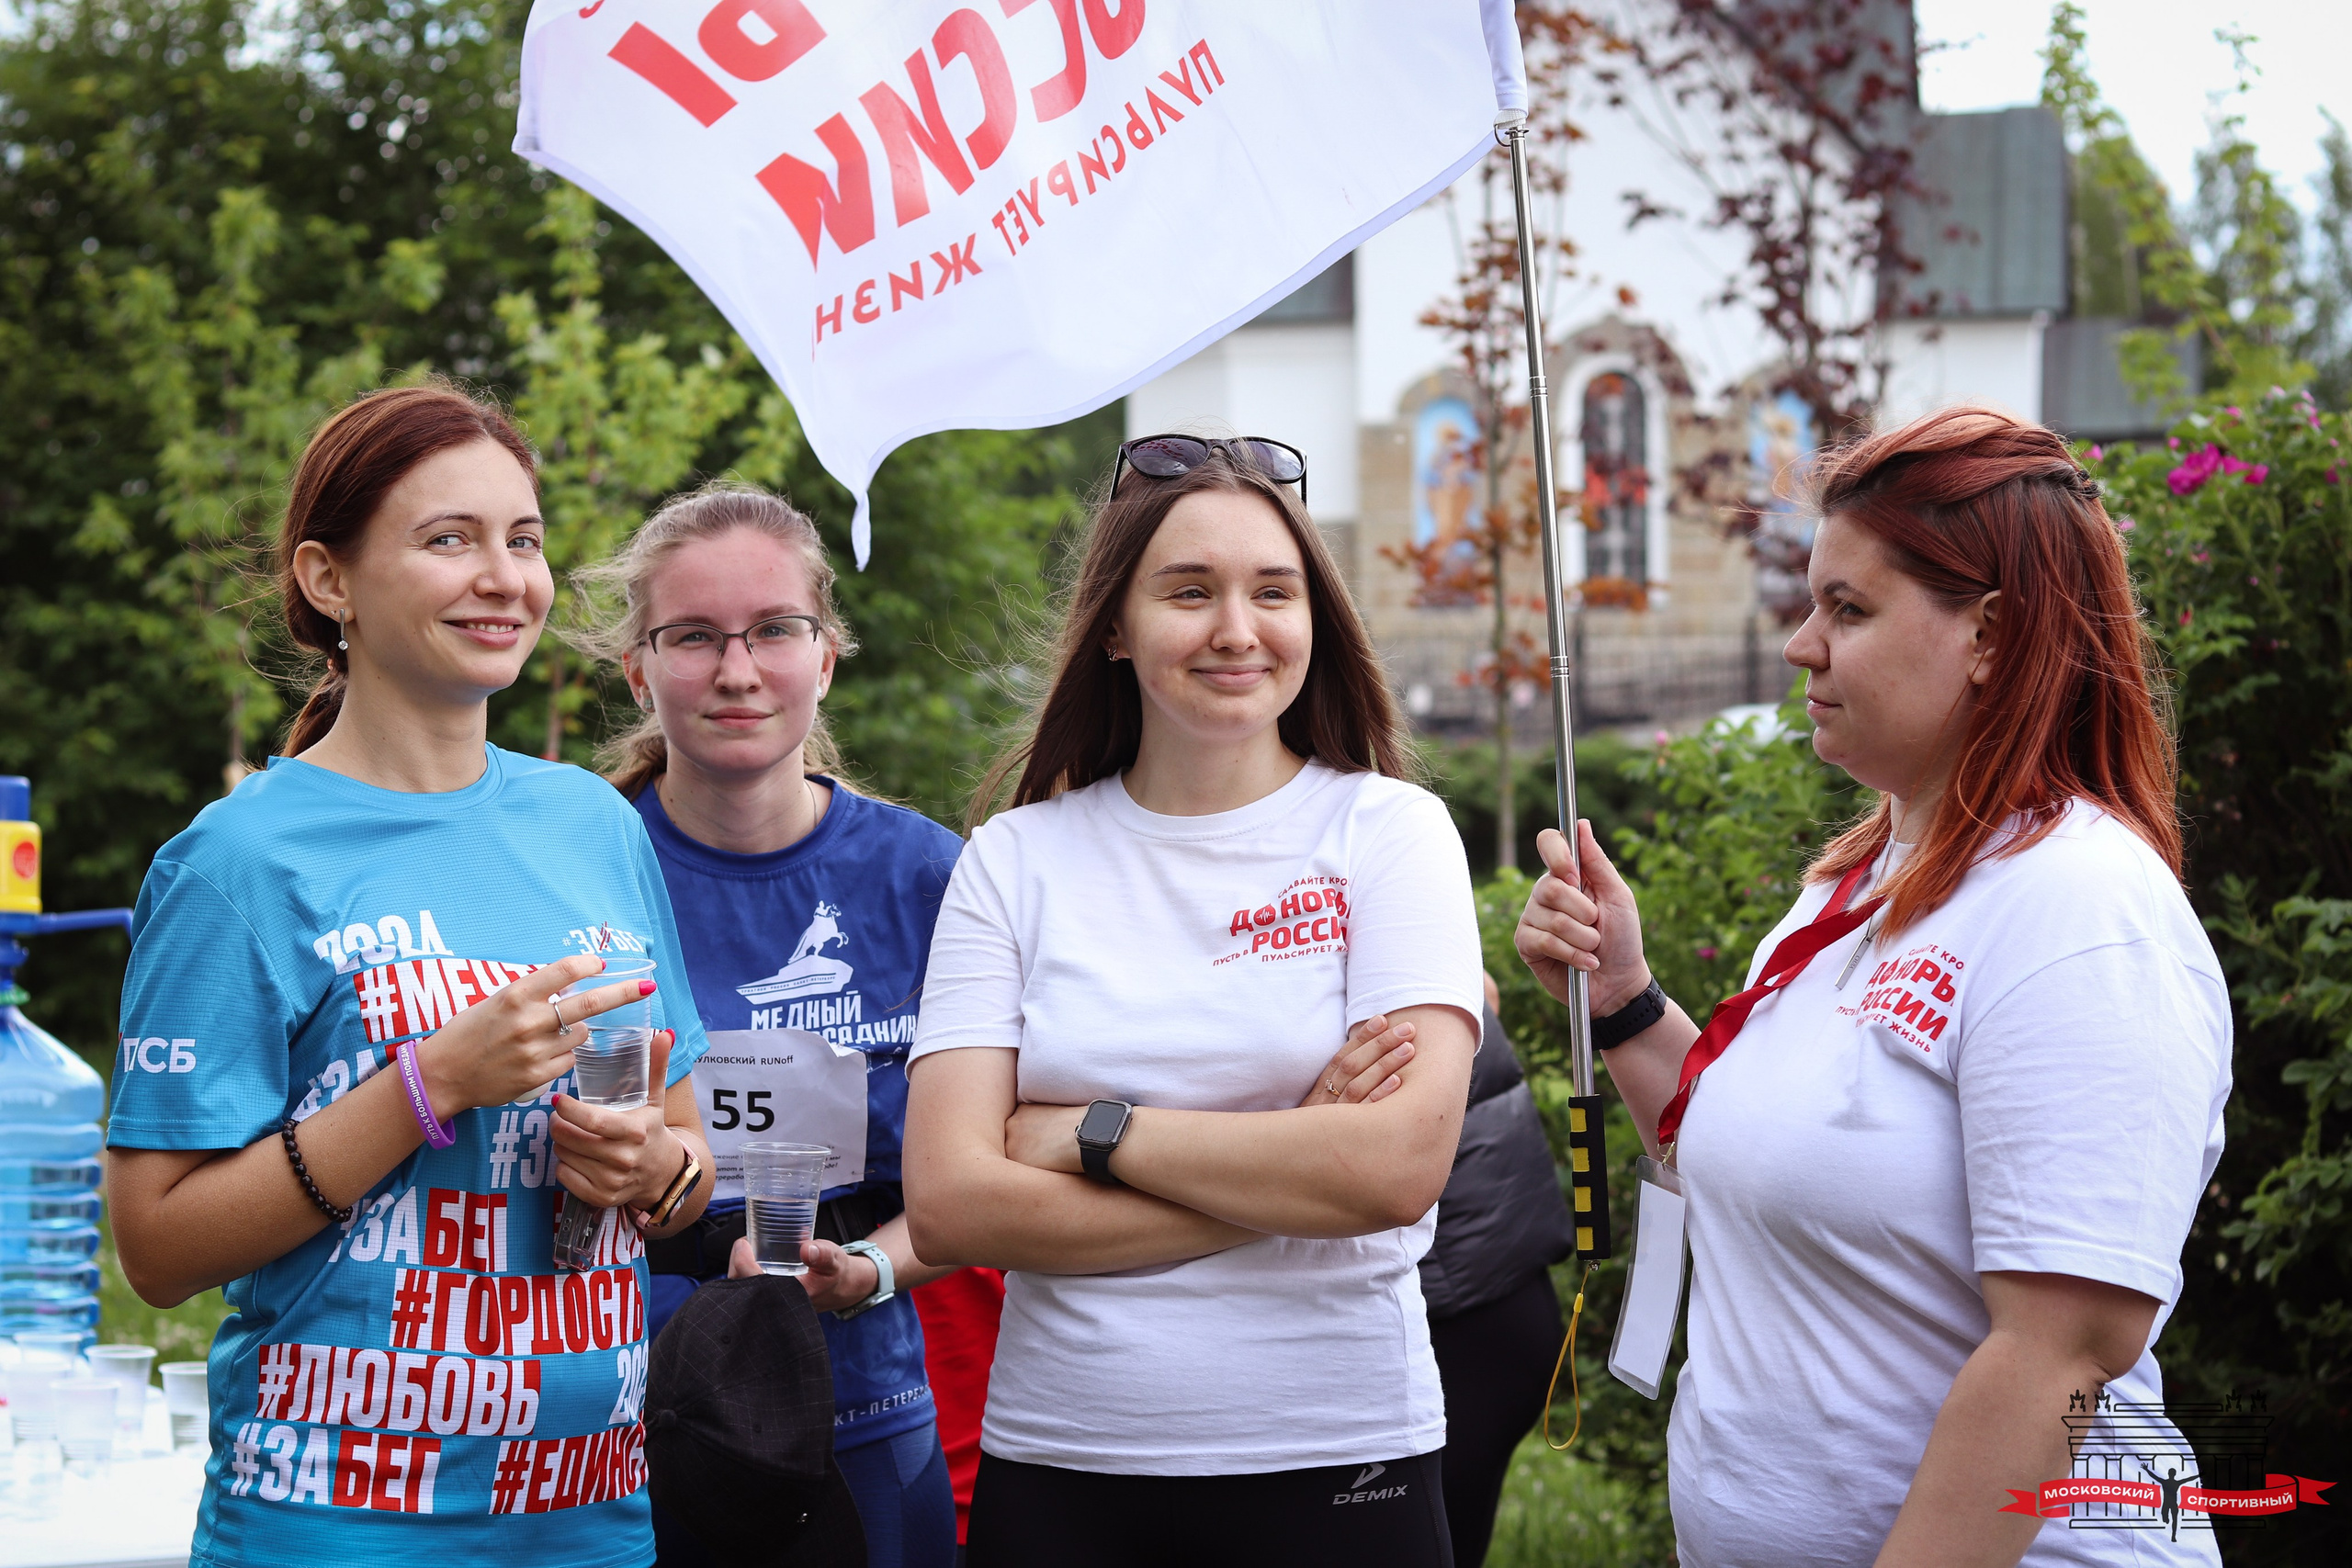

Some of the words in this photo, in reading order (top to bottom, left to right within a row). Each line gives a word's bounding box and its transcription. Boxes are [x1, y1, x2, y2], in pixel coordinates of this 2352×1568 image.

[1278, 875, 1325, 898] СДАВАЙТЕ
[1329, 876, 1349, 886] КРО
[1251, 916, 1348, 954] РОССИ
[1261, 944, 1332, 963] ПУЛЬСИРУЕТ
[1213, 953, 1240, 966] ПУСТЬ
[1940, 950, 1964, 970] КРО
[355, 958, 557, 1043] #МЕЧТ
[751, 989, 862, 1031] МЕДНЫЙ
[1860, 987, 1949, 1042] РОССИИ
[1888, 1021, 1931, 1053] ЖИЗНЬ
[695, 1055, 755, 1065] УЛКОВСКИЙ
[761, 1055, 794, 1066] RUNoff
[407, 1076, 427, 1118] БОЛЬШИМ
[712, 1089, 775, 1132] 55
[426, 1122, 440, 1140] ПУТЬ
[390, 1268, 644, 1356] #ГОРДОСТЬ
[256, 1343, 540, 1437] #ЛЮБОВЬ
[231, 1422, 442, 1514] #ЗАБЕГ
[490, 1426, 649, 1515] #ЕДИНС
[1332, 1484, 1408, 1506] DEMIX
